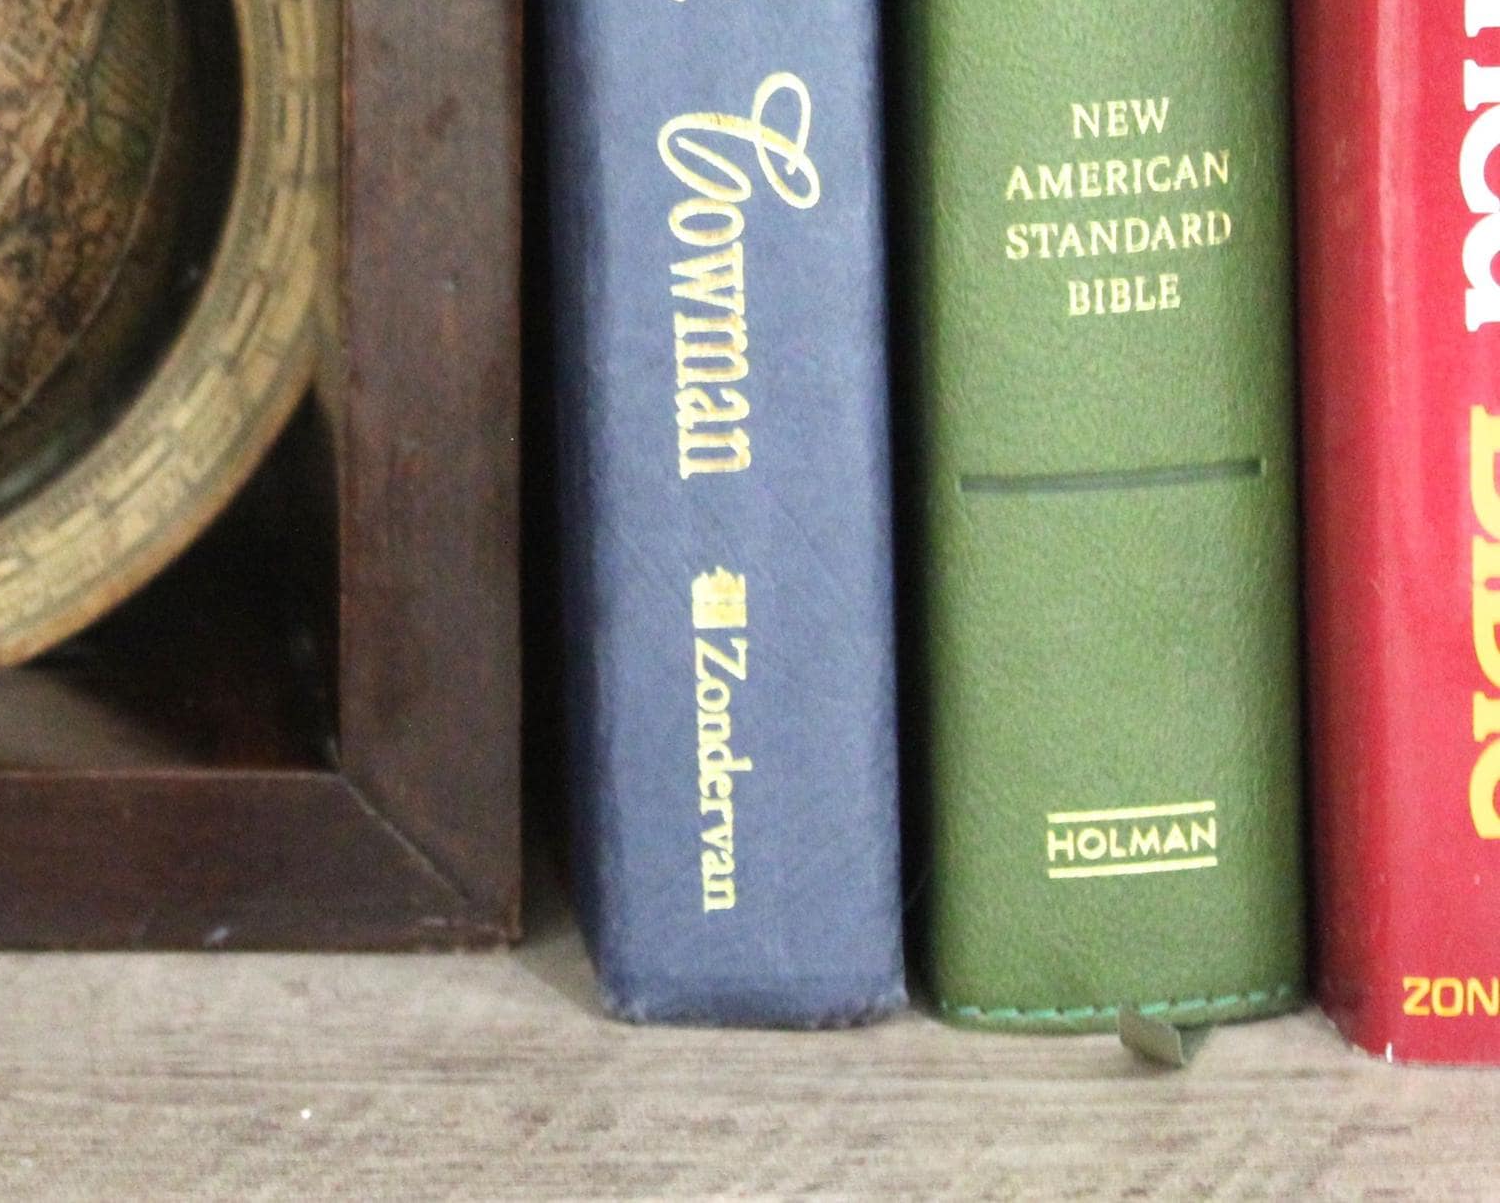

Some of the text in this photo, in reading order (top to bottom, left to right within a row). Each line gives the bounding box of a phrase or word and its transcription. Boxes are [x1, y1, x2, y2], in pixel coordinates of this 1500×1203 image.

[1070, 96, 1170, 139] NEW
[1005, 148, 1231, 201] AMERICAN
[1005, 210, 1232, 260] STANDARD
[656, 71, 821, 480] Cowman
[1067, 273, 1181, 317] BIBLE
[691, 636, 754, 913] Zondervan
[1046, 816, 1217, 862] HOLMAN
